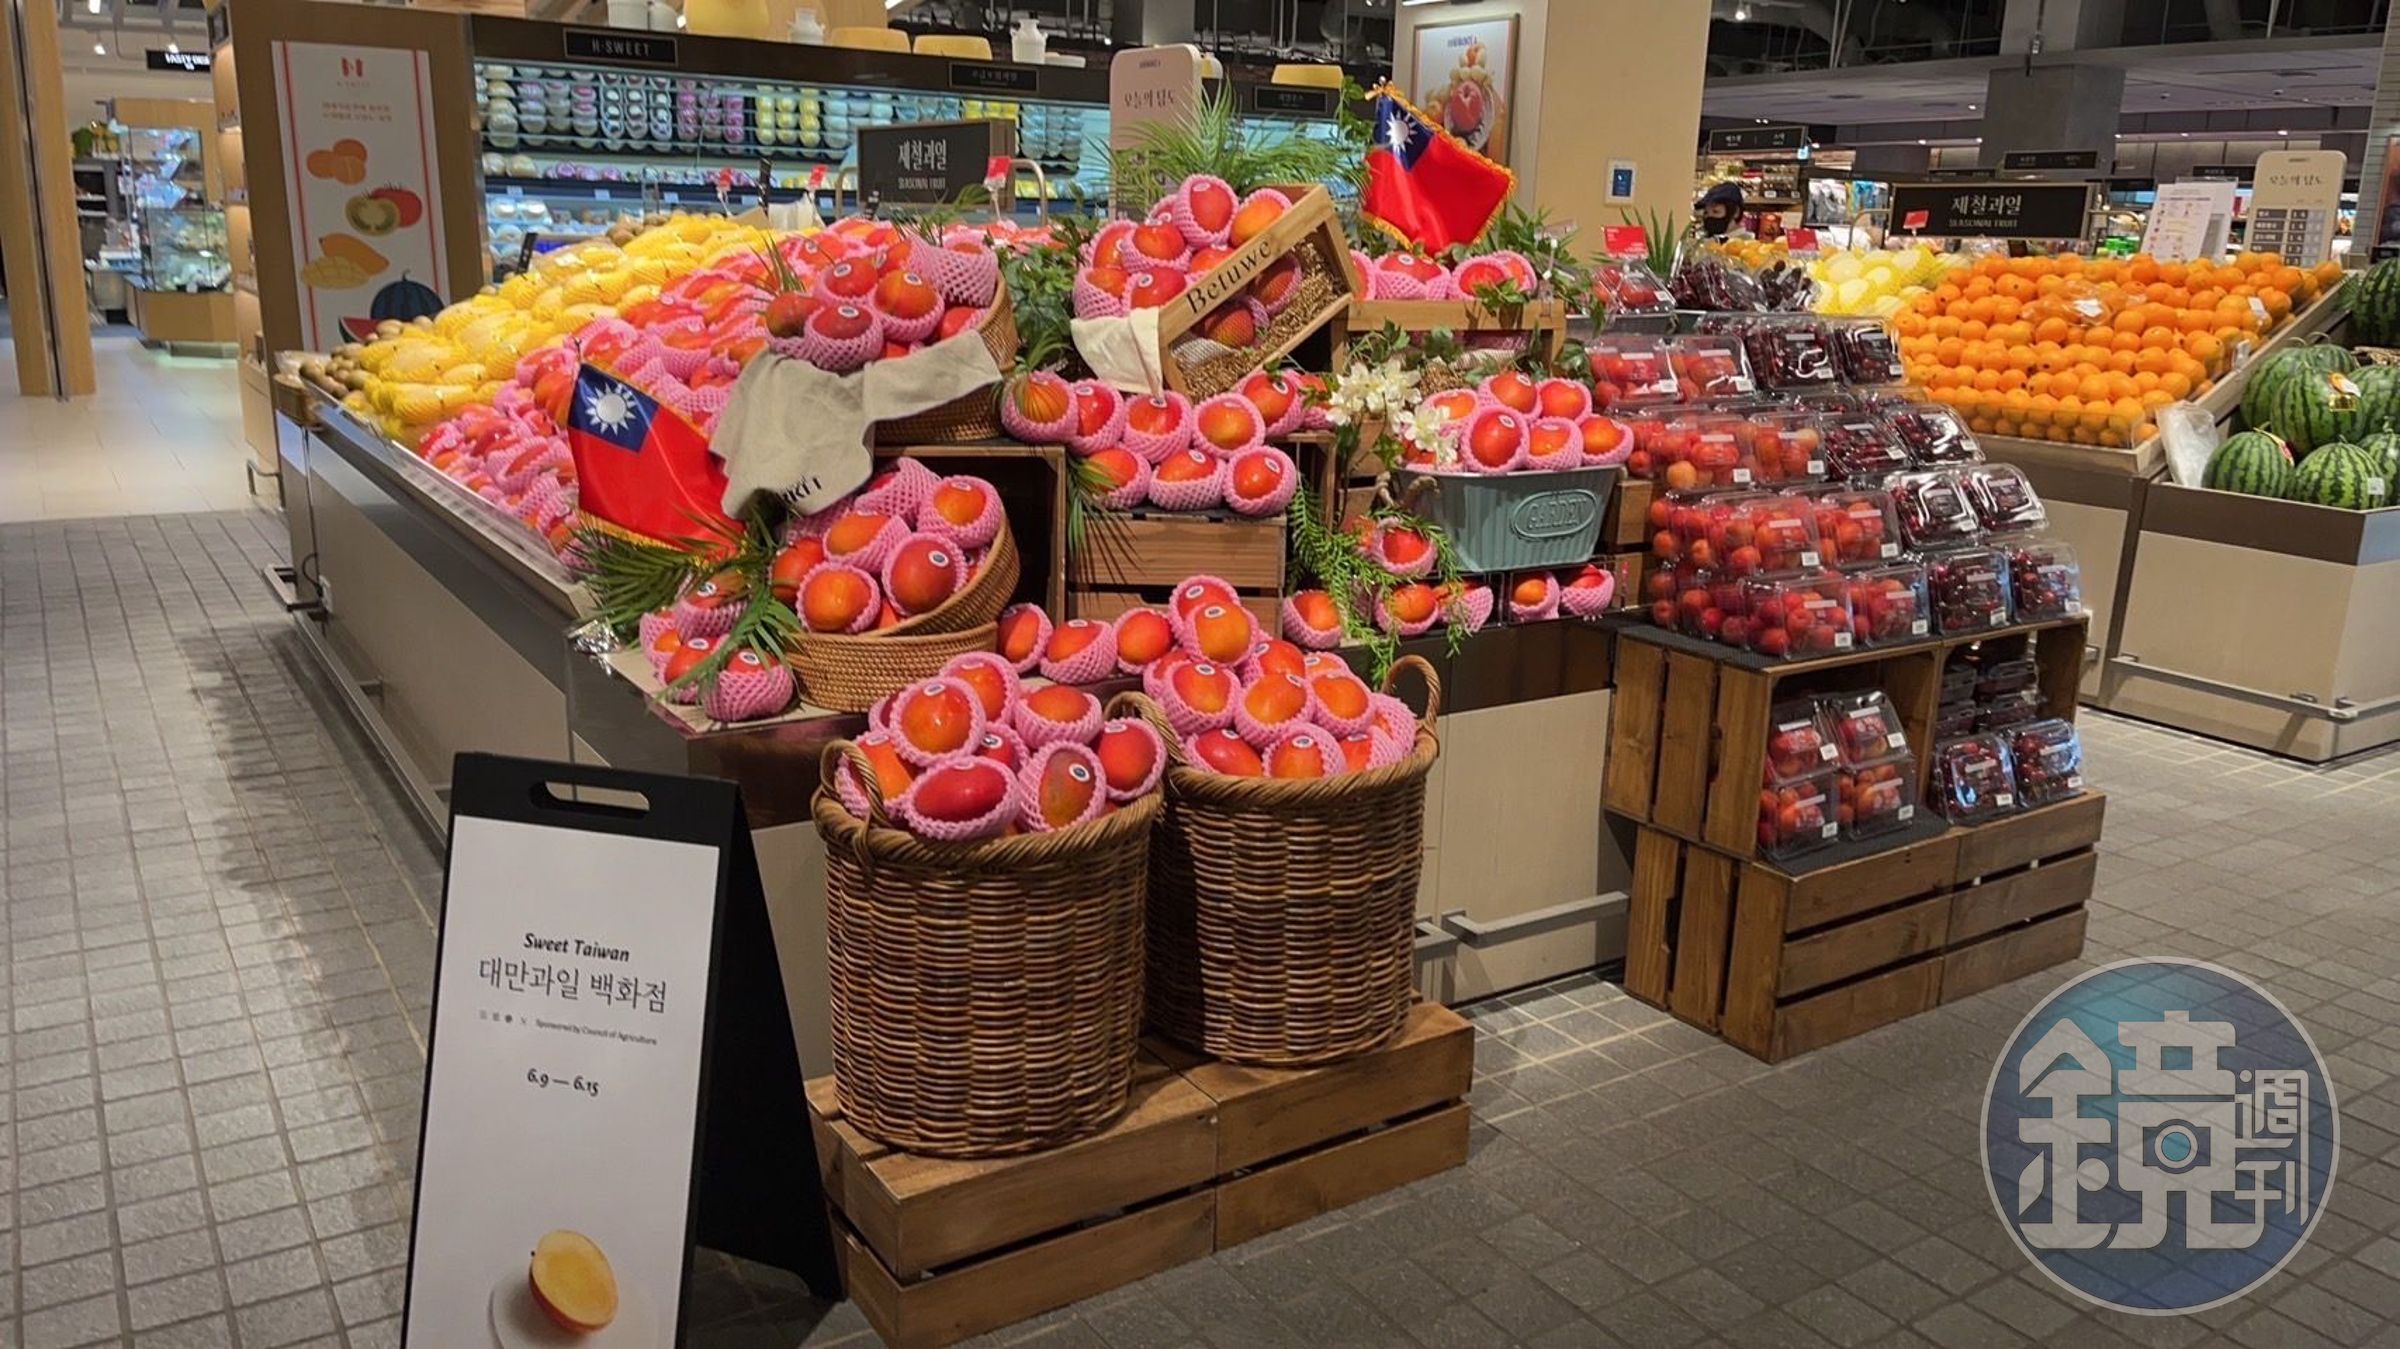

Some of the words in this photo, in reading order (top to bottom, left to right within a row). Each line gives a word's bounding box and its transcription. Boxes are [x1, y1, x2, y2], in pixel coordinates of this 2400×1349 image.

[897, 139, 948, 171] 제철과일
[1951, 194, 2022, 216] 제철과일
[523, 932, 569, 955] Sweet
[574, 938, 630, 962] Taiwan
[479, 956, 579, 1001] 대만과일
[590, 972, 666, 1014] 백화점
